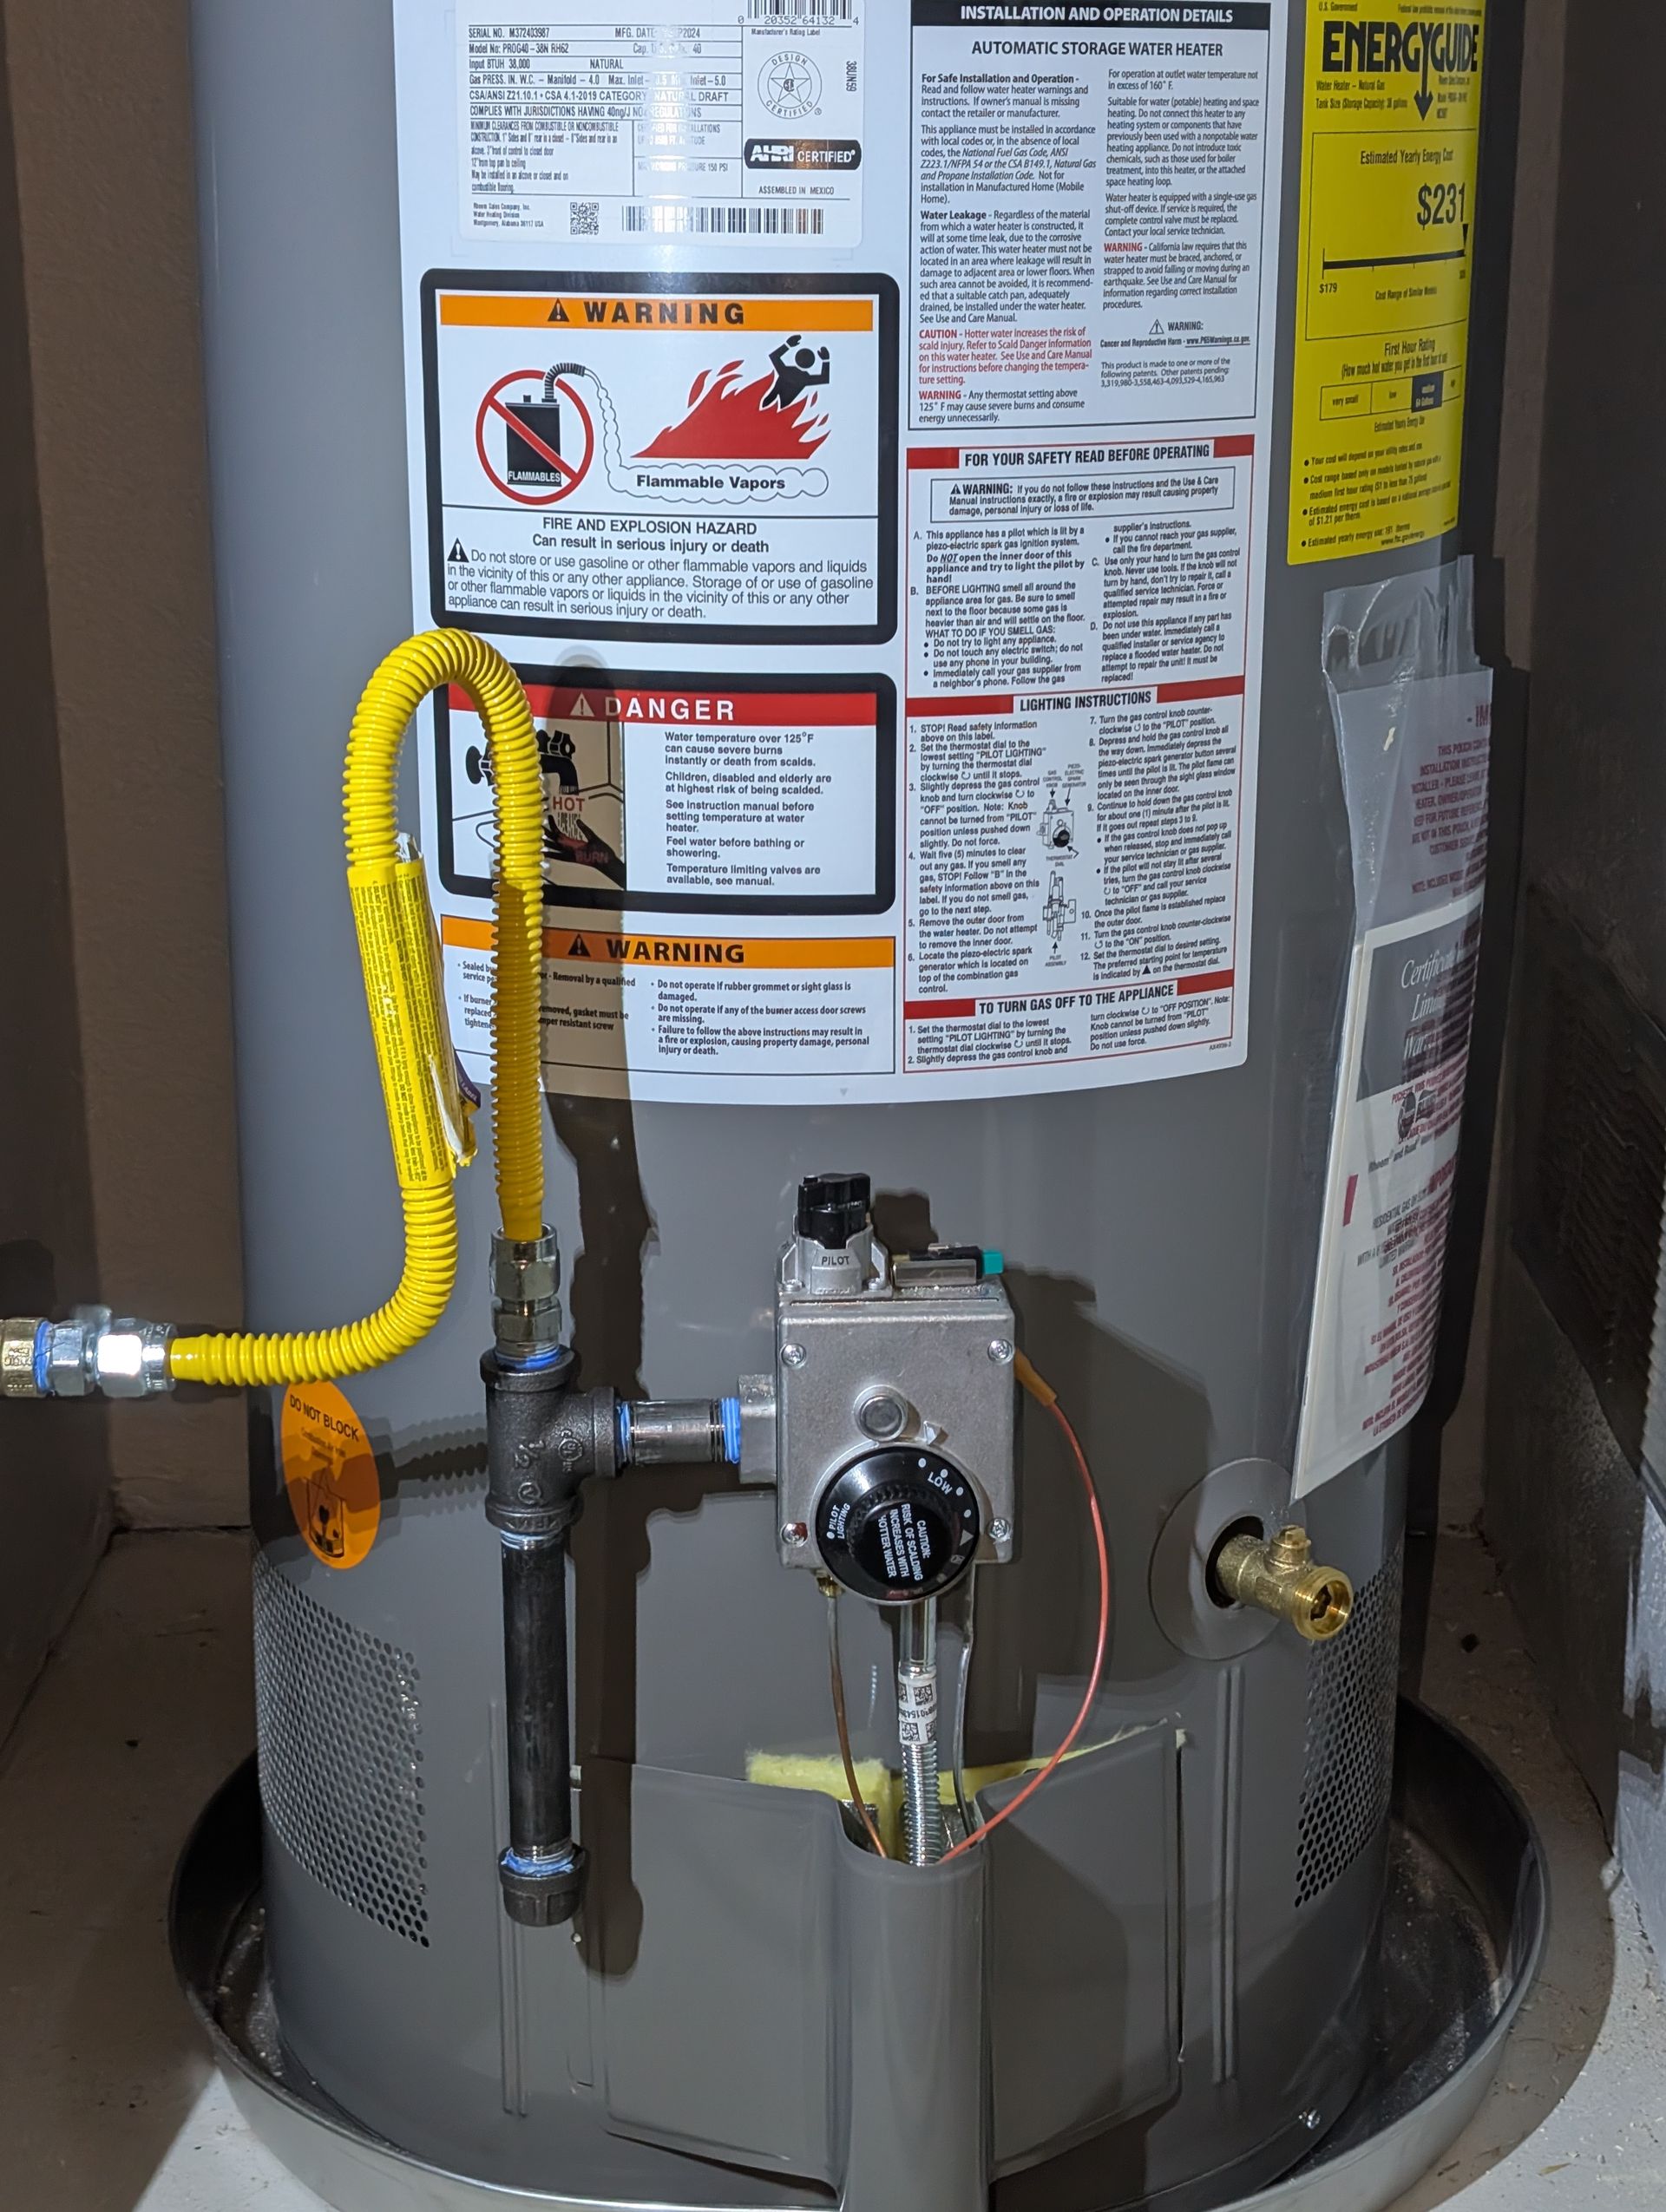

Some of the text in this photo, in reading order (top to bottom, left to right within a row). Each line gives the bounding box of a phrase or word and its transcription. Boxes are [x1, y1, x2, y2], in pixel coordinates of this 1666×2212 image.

[764, 16, 796, 24] 20352
[961, 5, 1233, 23] INSTALLATION AND OPERATION DETAILS
[469, 27, 549, 38] SERIAL NO. M372403987
[614, 27, 633, 37] MFG.
[789, 28, 805, 37] Rating
[469, 43, 488, 54] Model
[489, 43, 501, 54] No:
[550, 43, 568, 54] RH62
[971, 41, 1223, 56] AUTOMATIC STORAGE WATER HEATER
[469, 58, 530, 71] Input BTUH 38,000
[589, 58, 624, 69] NATURAL
[771, 54, 809, 67] DESIGN
[922, 73, 936, 82] For
[937, 73, 958, 82] Safe
[960, 73, 1011, 83] Installation
[1012, 73, 1029, 83] and
[1031, 73, 1074, 85] Operation
[469, 105, 630, 120] COMPLIES WITH JURISDICTIONS HAVING 40ng/J
[765, 100, 814, 117] CERTIFIED
[750, 146, 793, 163] AHRI
[1360, 147, 1453, 166] Estimated Yearly Energy Cost
[758, 185, 797, 194] ASSEMBLED
[810, 186, 834, 195] MEXICO
[1417, 181, 1466, 228] $231
[1320, 283, 1337, 293] $179
[584, 302, 744, 324] WARNING
[919, 329, 957, 339] CAUTION
[964, 329, 989, 338] Hotter
[990, 329, 1013, 338] water
[1013, 328, 1048, 337] increases
[1049, 327, 1062, 337] the
[1063, 326, 1077, 337] risk
[1077, 326, 1086, 337] of
[1167, 321, 1204, 331] WARNING:
[1384, 337, 1435, 357] First Hour Rating
[1332, 394, 1359, 407] very small
[965, 444, 1210, 467] FOR YOUR SAFETY READ BEFORE OPERATING
[508, 470, 561, 483] FLAMMABLES
[637, 474, 785, 492] Flammable Vapors
[962, 483, 1013, 495] WARNING:
[542, 516, 757, 534] FIRE AND EXPLOSION HAZARD
[1317, 515, 1332, 525] $1.21
[1334, 515, 1343, 524] per
[1345, 512, 1360, 521] therm
[532, 533, 769, 555] Can result in serious injury or death
[926, 574, 952, 584] hand!
[1103, 609, 1138, 619] explosion.
[925, 625, 1055, 638] WHAT TO DO IF YOU SMELL GAS:
[1020, 690, 1151, 711] LIGHTING INSTRUCTIONS
[605, 697, 735, 721] DANGER
[665, 731, 814, 744] Water temperature over 125°F
[920, 733, 944, 743] above
[958, 732, 973, 741] this
[974, 731, 995, 741] label.
[553, 797, 585, 812] HOT
[666, 836, 686, 846] Feel
[689, 837, 717, 847] water
[718, 837, 751, 847] before
[753, 838, 791, 849] bathing
[575, 851, 608, 863] BURN
[666, 848, 720, 860] showering.
[605, 938, 744, 963] WARNING
[979, 984, 1174, 1014] TO TURN GAS OFF TO THE APPLIANCE
[658, 1044, 681, 1056] injury
[692, 1045, 718, 1055] death.
[822, 1255, 849, 1266] PILOT
[290, 1394, 359, 1441] DO NOT BLOCK
[928, 1471, 953, 1495] LOW
[829, 1505, 840, 1530] PILOT
[837, 1503, 850, 1539] LIGHTING
[889, 1508, 909, 1577] INCREASES WITH
[901, 1503, 923, 1580] RISK OF SCALDING
[917, 1520, 931, 1558] CAUTION:
[883, 1549, 896, 1578] WATER
